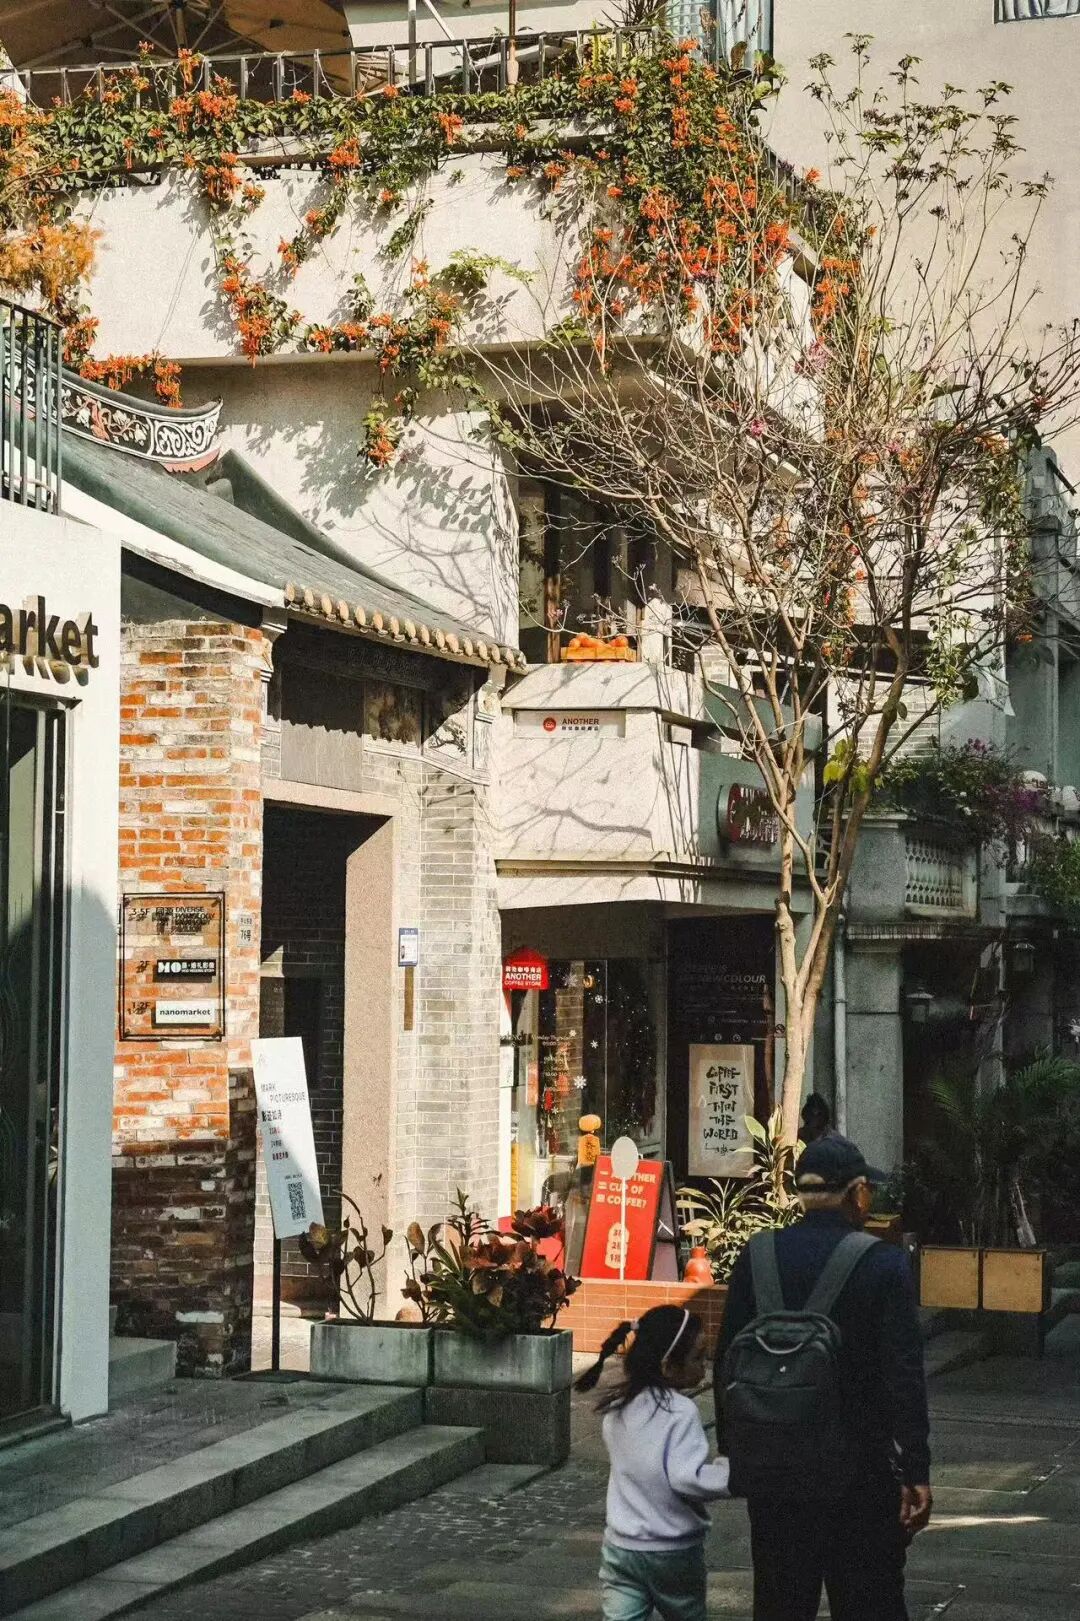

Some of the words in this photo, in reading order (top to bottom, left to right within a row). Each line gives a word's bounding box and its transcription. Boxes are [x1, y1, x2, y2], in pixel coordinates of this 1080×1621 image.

[505, 973, 542, 981] ANOTHER
[724, 974, 767, 984] COLOUR
[709, 1081, 738, 1099] FIRST
[709, 1115, 735, 1126] THE
[631, 1185, 644, 1195] OF
